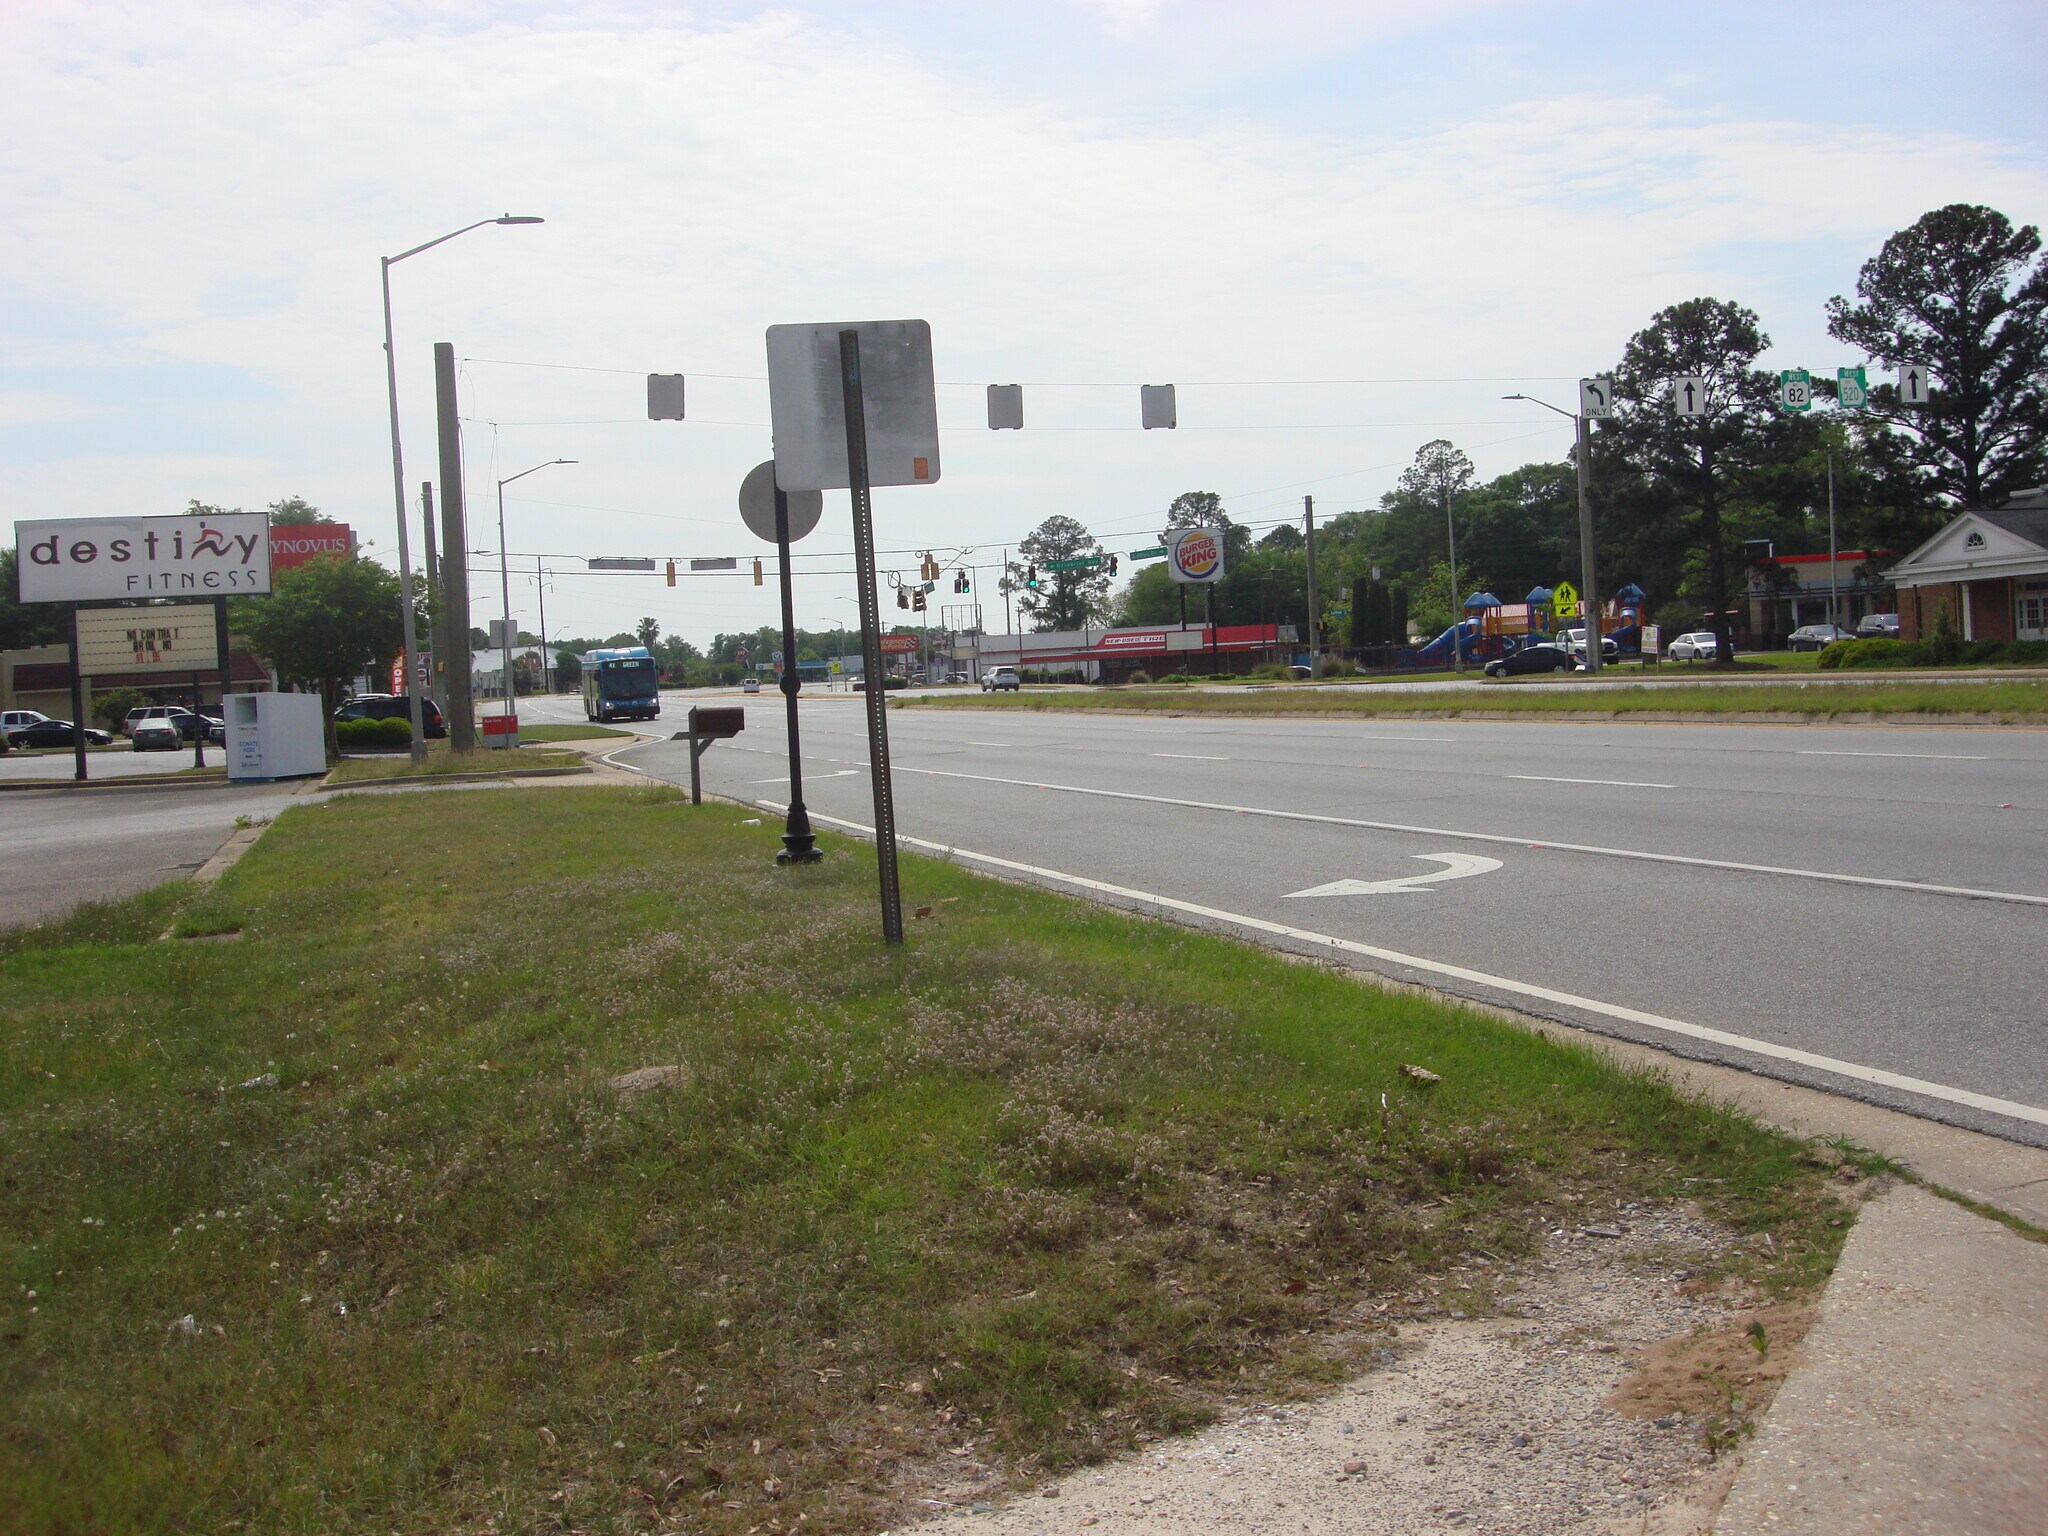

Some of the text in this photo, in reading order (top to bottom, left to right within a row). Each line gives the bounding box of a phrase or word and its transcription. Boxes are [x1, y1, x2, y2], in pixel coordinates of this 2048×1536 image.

[1788, 373, 1803, 381] WEST
[1788, 387, 1804, 402] 82
[1843, 386, 1860, 401] 520
[1585, 408, 1607, 416] ONLY
[270, 538, 346, 554] YNOVUS
[1180, 538, 1215, 557] BURGER
[1182, 547, 1217, 570] KING
[126, 569, 258, 592] FITNESS
